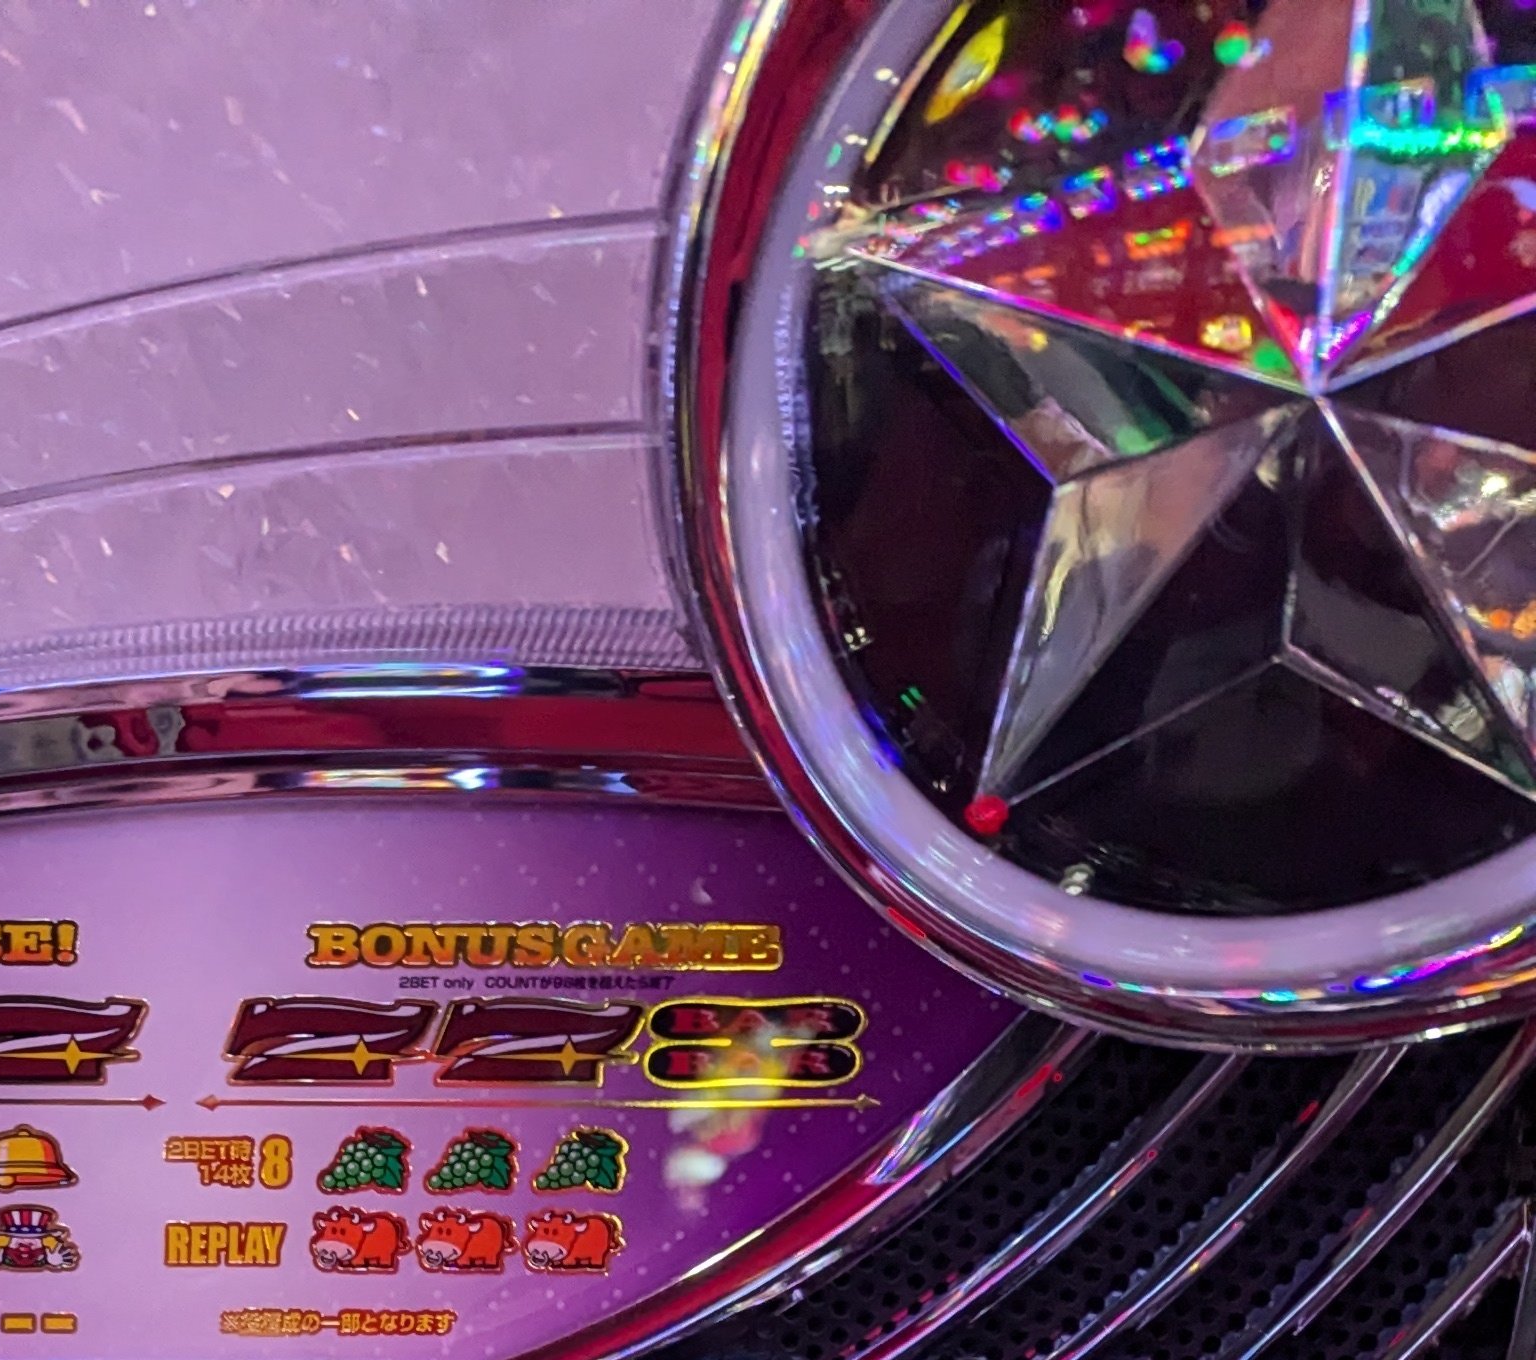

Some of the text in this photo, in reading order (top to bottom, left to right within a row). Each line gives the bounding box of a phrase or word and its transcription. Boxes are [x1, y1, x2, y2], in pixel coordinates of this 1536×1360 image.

[306, 920, 782, 970] BONUS GAME
[398, 976, 438, 989] 2BET
[443, 976, 475, 990] only
[260, 1135, 292, 1188] 8
[165, 1223, 286, 1265] REPLAY
